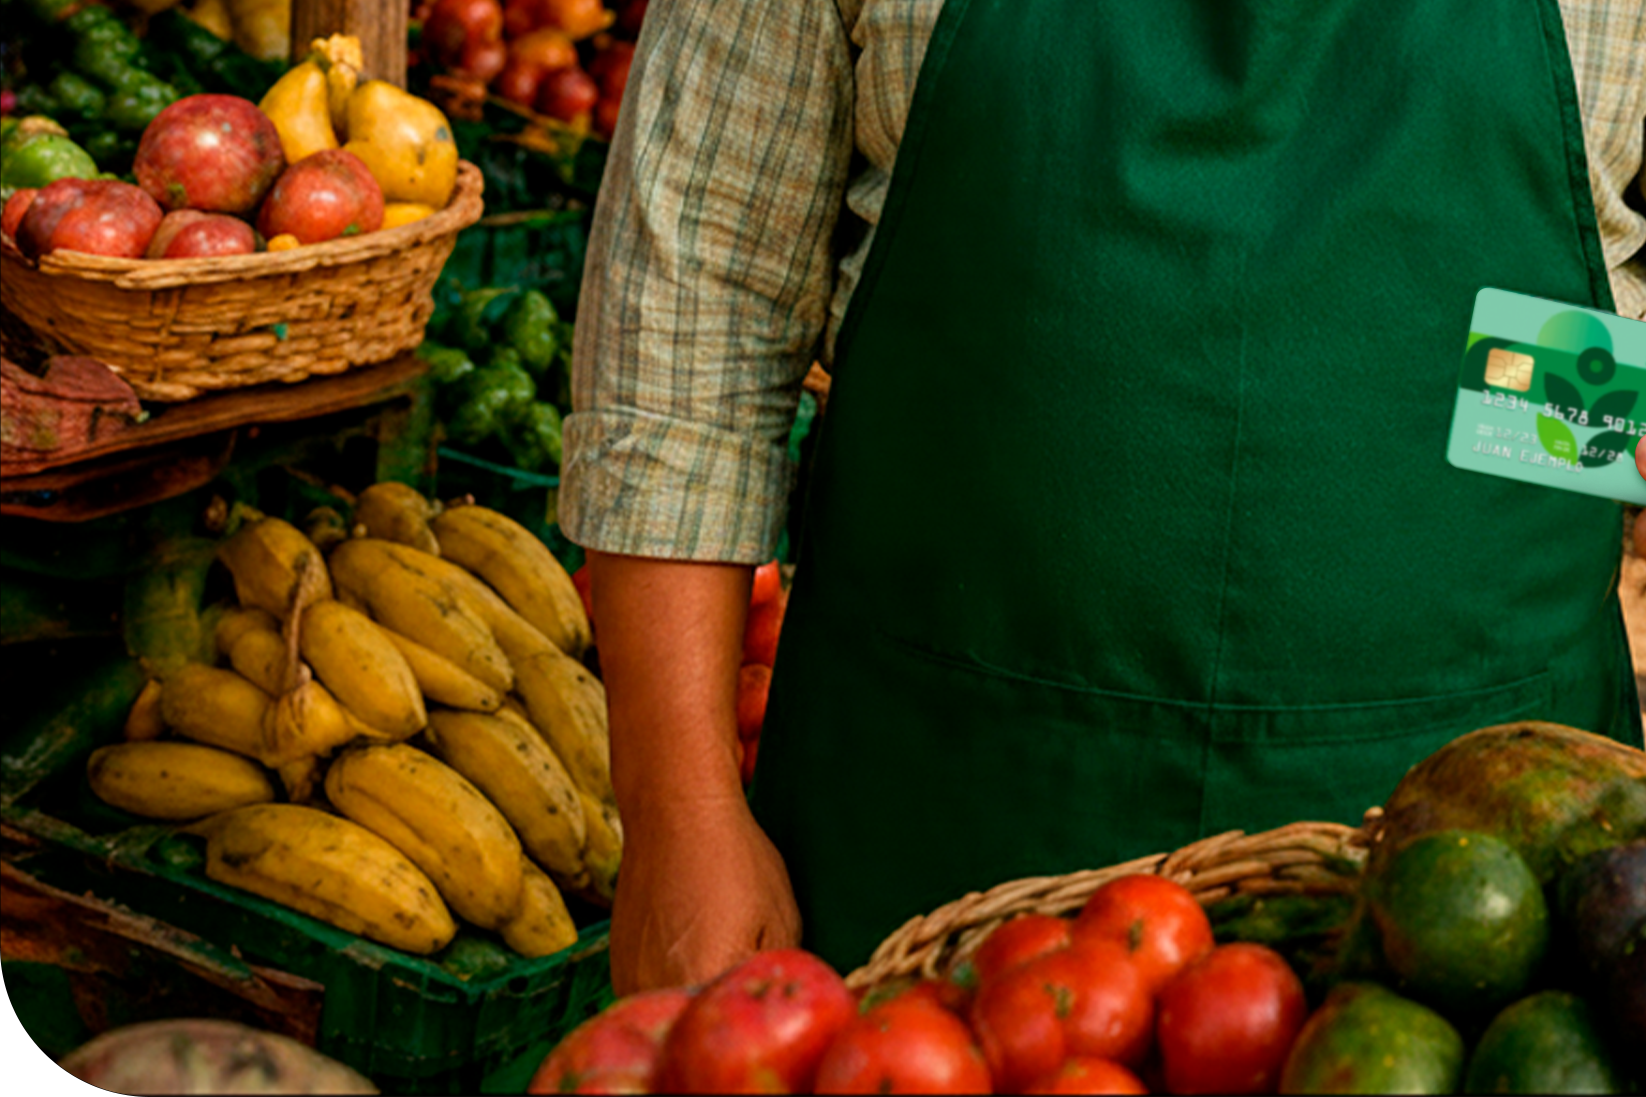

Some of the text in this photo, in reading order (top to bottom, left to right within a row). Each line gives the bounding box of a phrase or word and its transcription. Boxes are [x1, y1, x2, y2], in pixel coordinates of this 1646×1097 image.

[1481, 389, 1529, 413] 1234
[1542, 402, 1588, 426] 5678
[1495, 426, 1537, 445] 12/23
[1472, 440, 1583, 473] JUAN EJEMPLO
